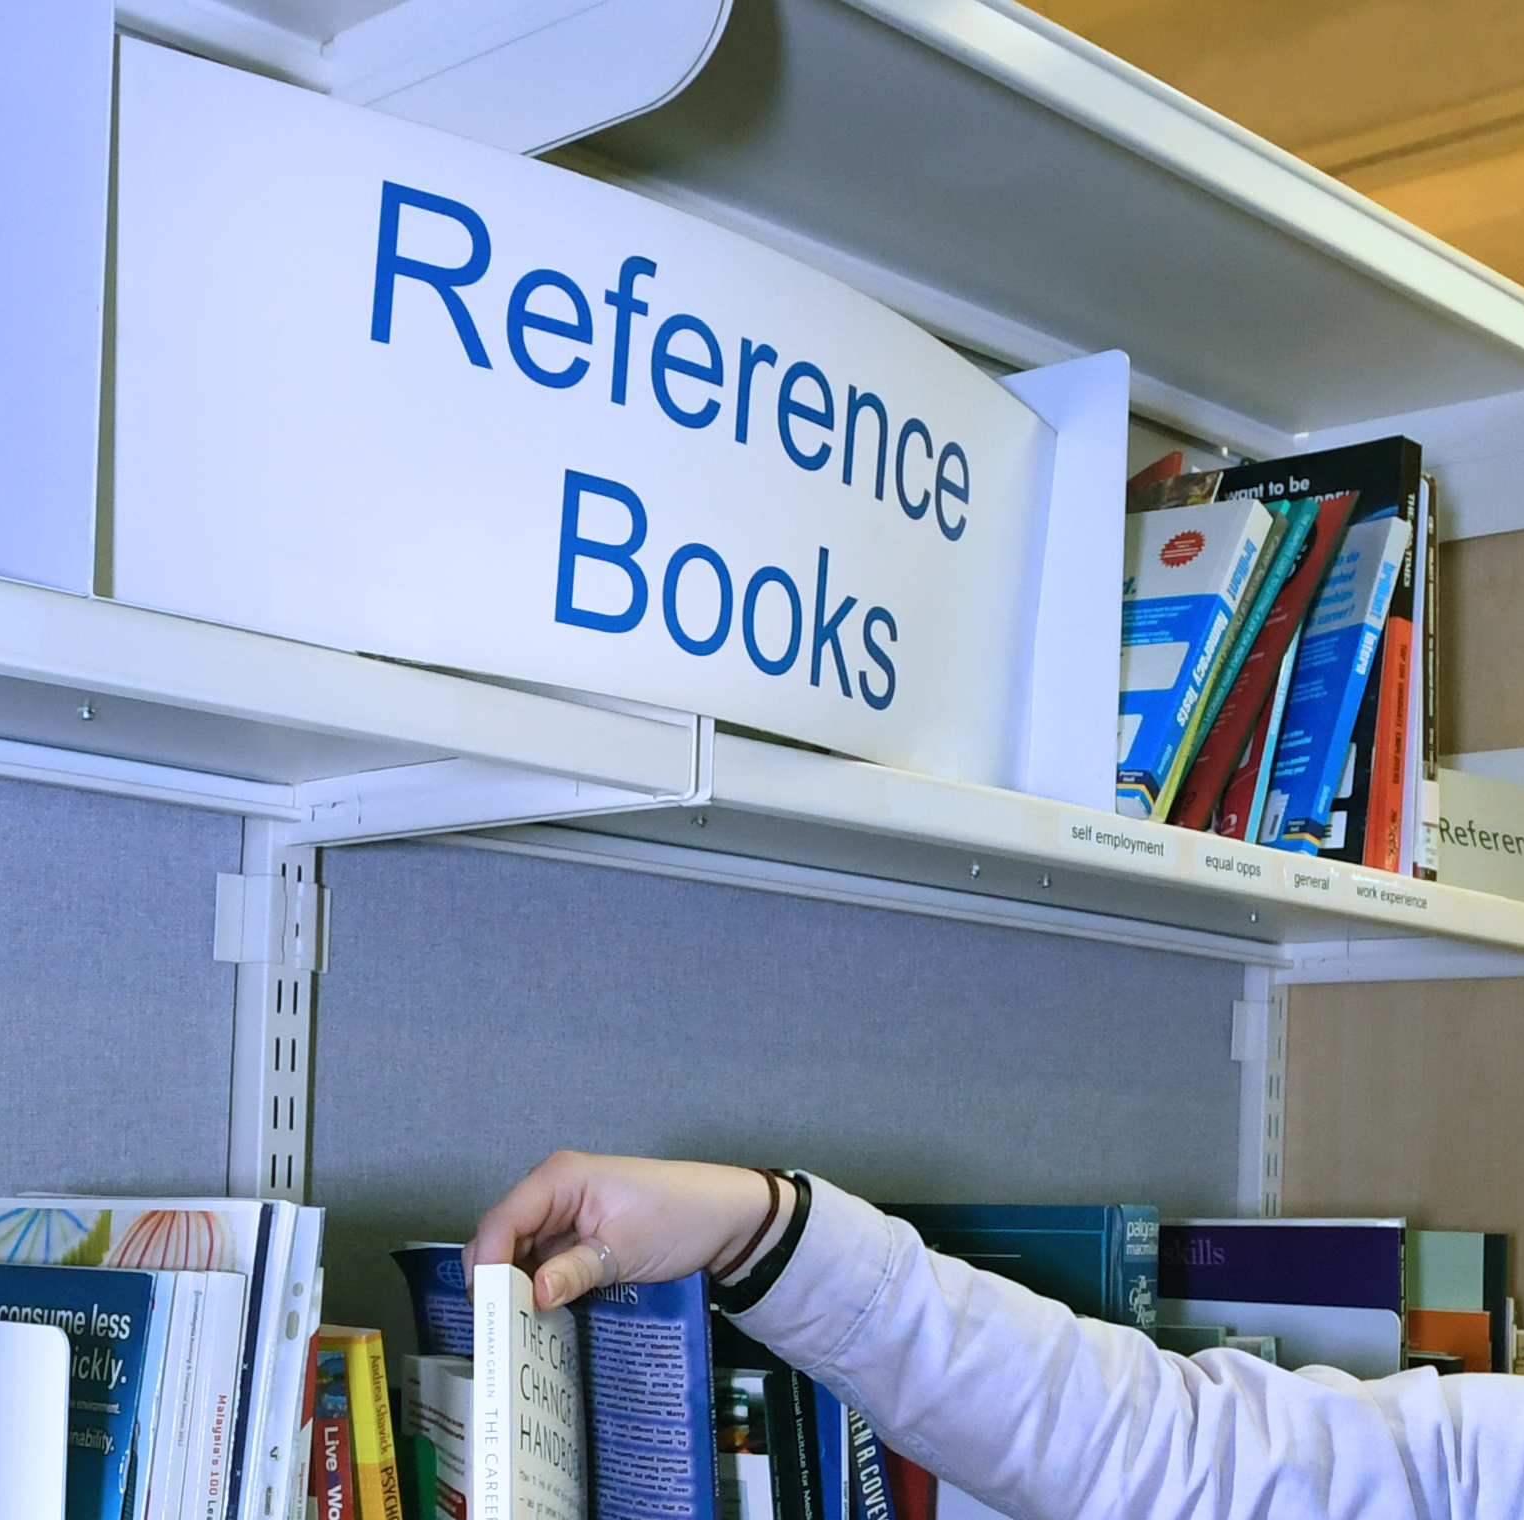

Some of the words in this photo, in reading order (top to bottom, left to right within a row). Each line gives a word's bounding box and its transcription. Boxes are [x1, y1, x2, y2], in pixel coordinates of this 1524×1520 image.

[370, 179, 970, 542] Reference
[554, 468, 898, 711] Books
[1196, 609, 1229, 687] Numeracy
[1177, 683, 1200, 728] Tests
[1071, 824, 1092, 841] self
[1095, 831, 1164, 857] employment
[1205, 853, 1234, 874] equal
[1236, 860, 1261, 878] opps
[1294, 871, 1330, 892] general
[1356, 883, 1378, 900] work
[1380, 888, 1428, 910] experience
[486, 1302, 496, 1356] GRAHAM
[370, 1355, 384, 1402] Andrea
[487, 1359, 495, 1398] GREEN
[212, 1395, 227, 1466] Malaysia's
[375, 1405, 389, 1454] Shavick
[484, 1408, 498, 1445] THE
[796, 1418, 806, 1468] Institute
[801, 1470, 809, 1487] for
[209, 1470, 219, 1496] 100
